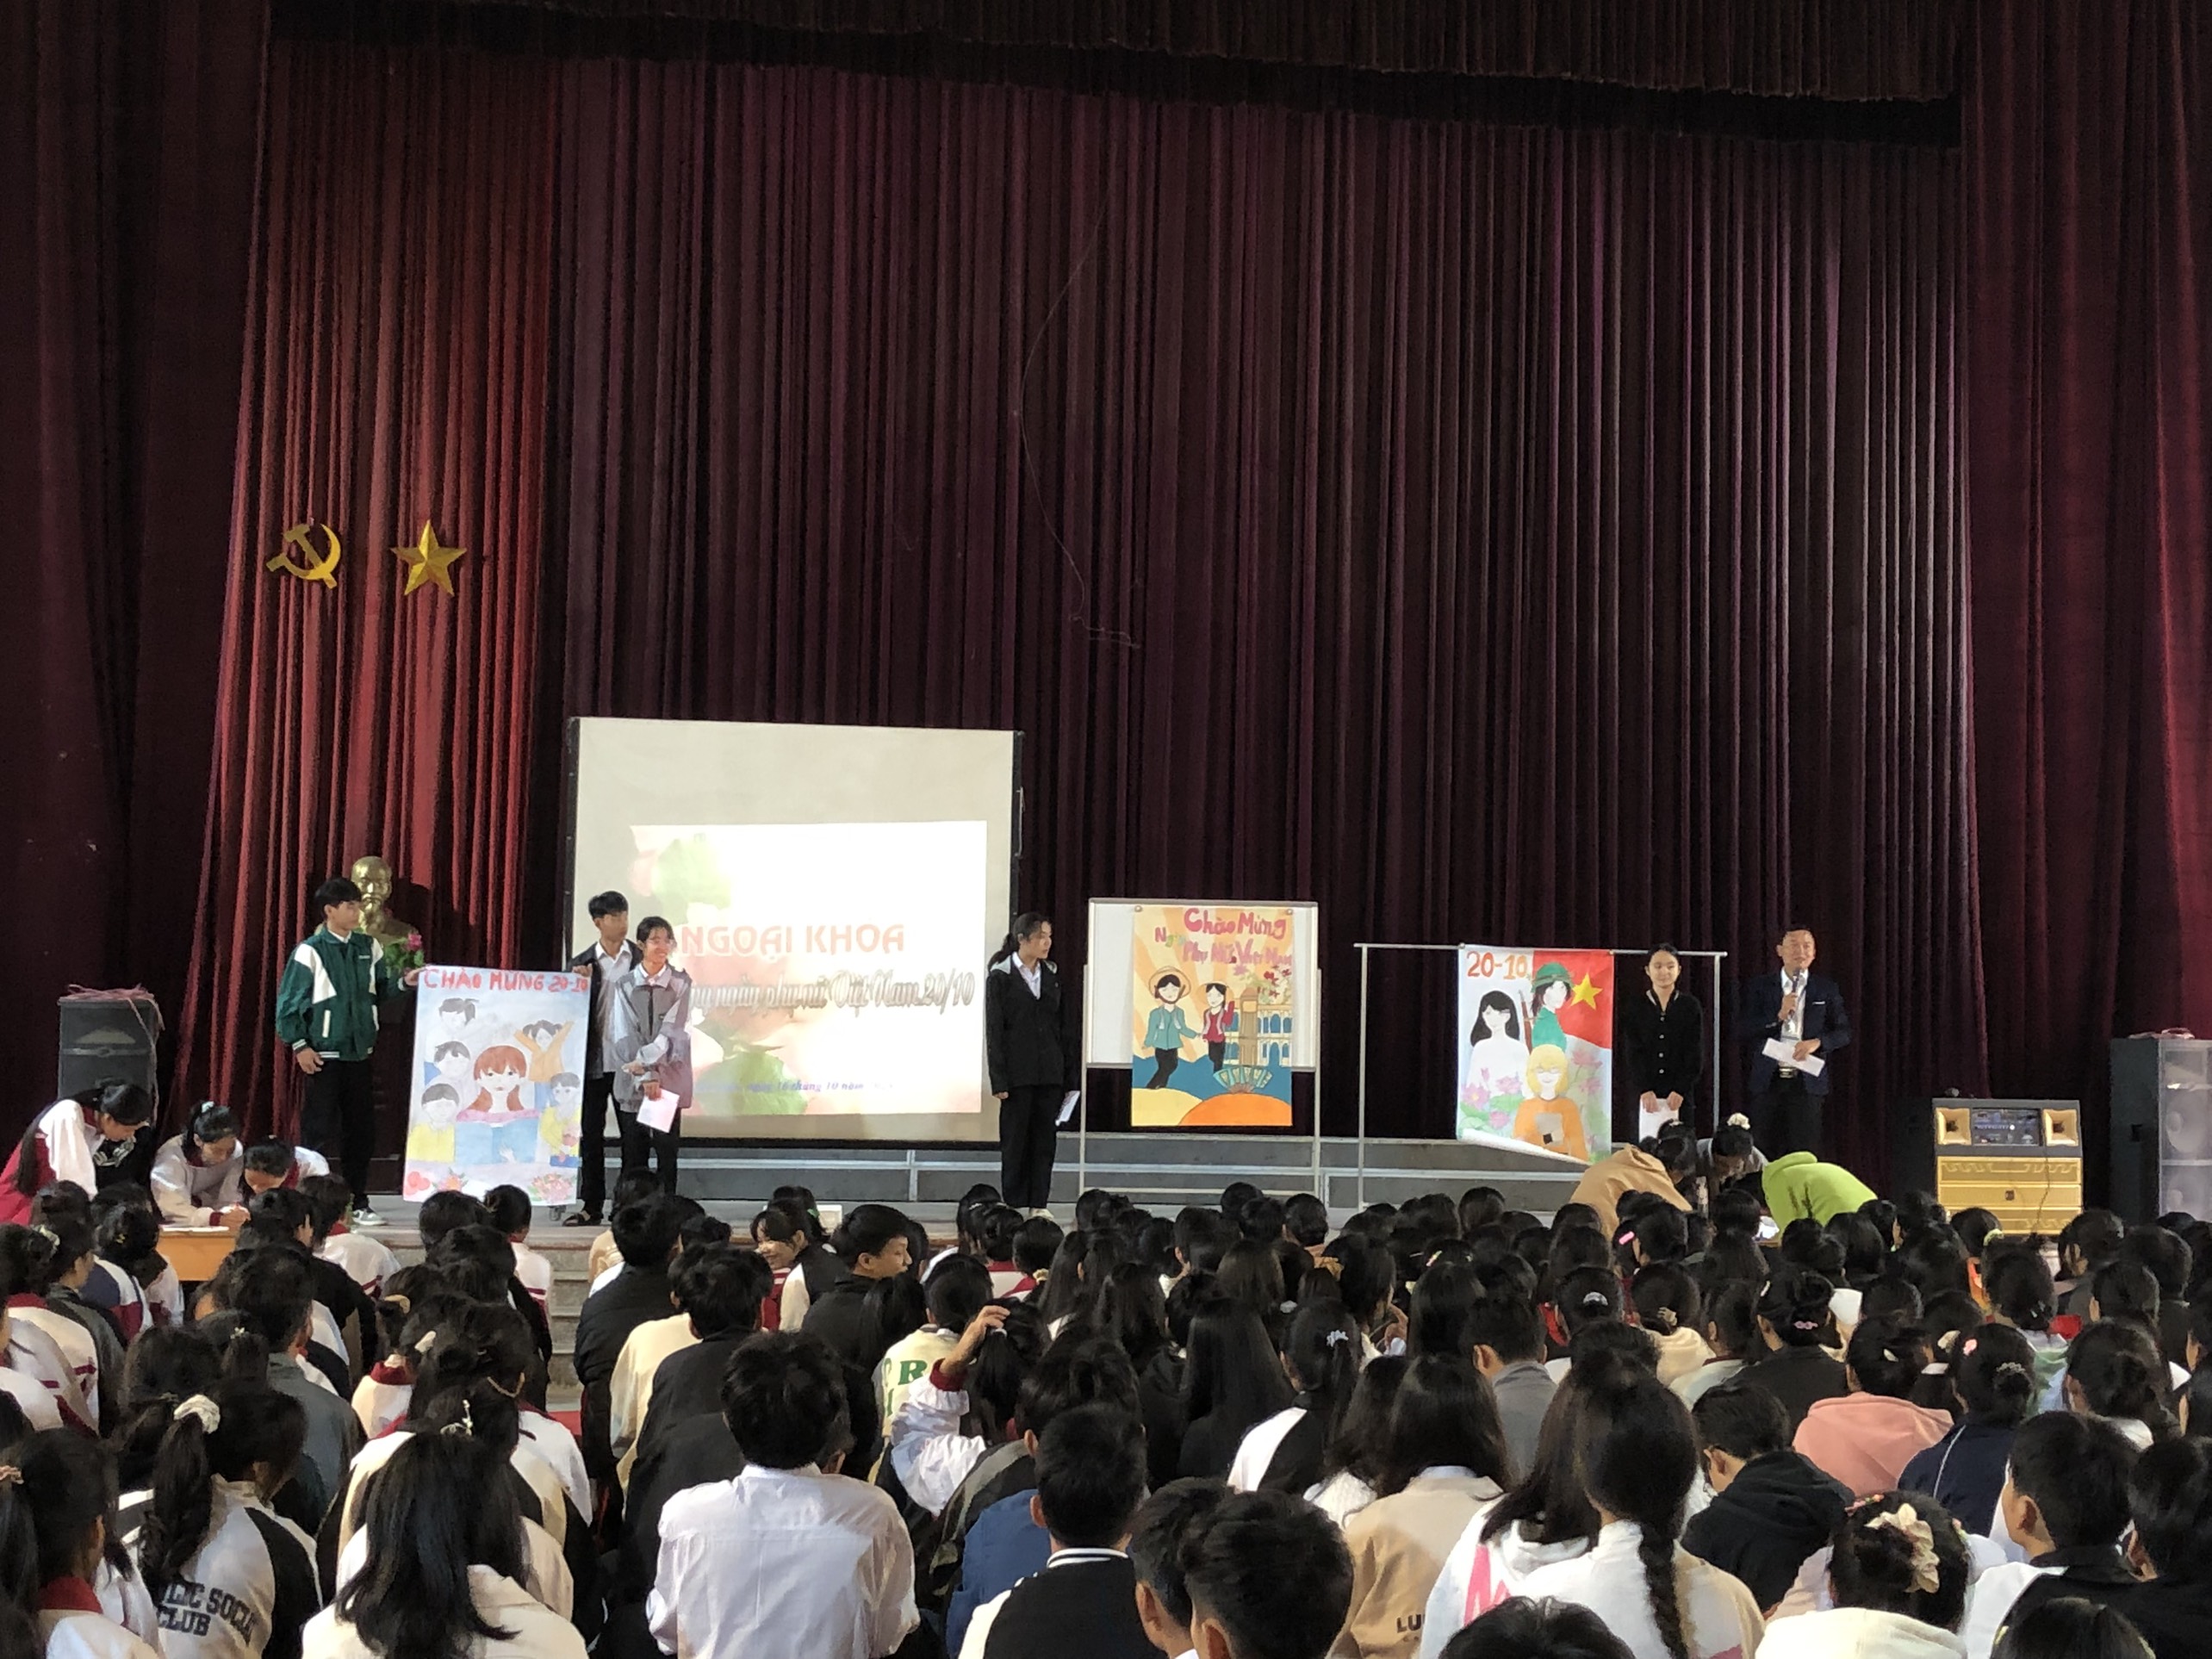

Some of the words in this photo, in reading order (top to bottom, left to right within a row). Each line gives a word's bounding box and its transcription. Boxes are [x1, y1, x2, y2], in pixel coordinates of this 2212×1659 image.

[1184, 907, 1236, 935] Chào
[680, 924, 792, 961] NGOẠI
[423, 966, 483, 991] CHÀO
[548, 976, 588, 992] 20-10
[1465, 950, 1528, 980] 20-10
[923, 967, 976, 1015] 20/10
[157, 1603, 212, 1637] CLUB
